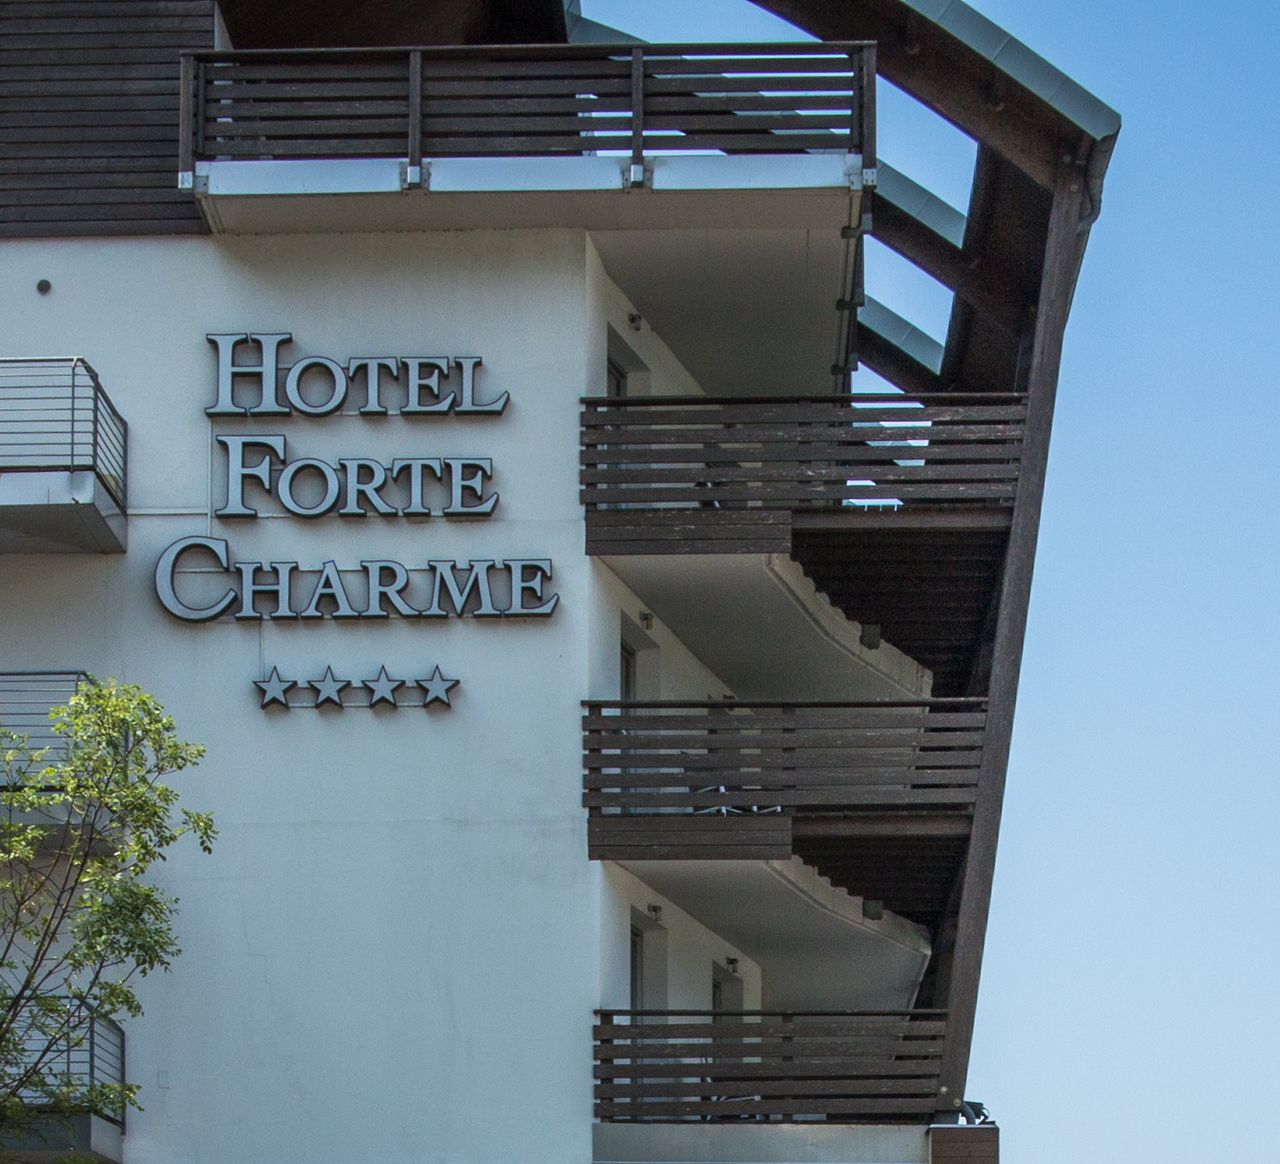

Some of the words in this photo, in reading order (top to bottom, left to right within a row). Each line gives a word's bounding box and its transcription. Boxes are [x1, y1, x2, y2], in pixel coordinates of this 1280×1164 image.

[204, 332, 510, 417] HOTEL
[214, 434, 500, 518] FORTE
[154, 535, 560, 622] CHARME
